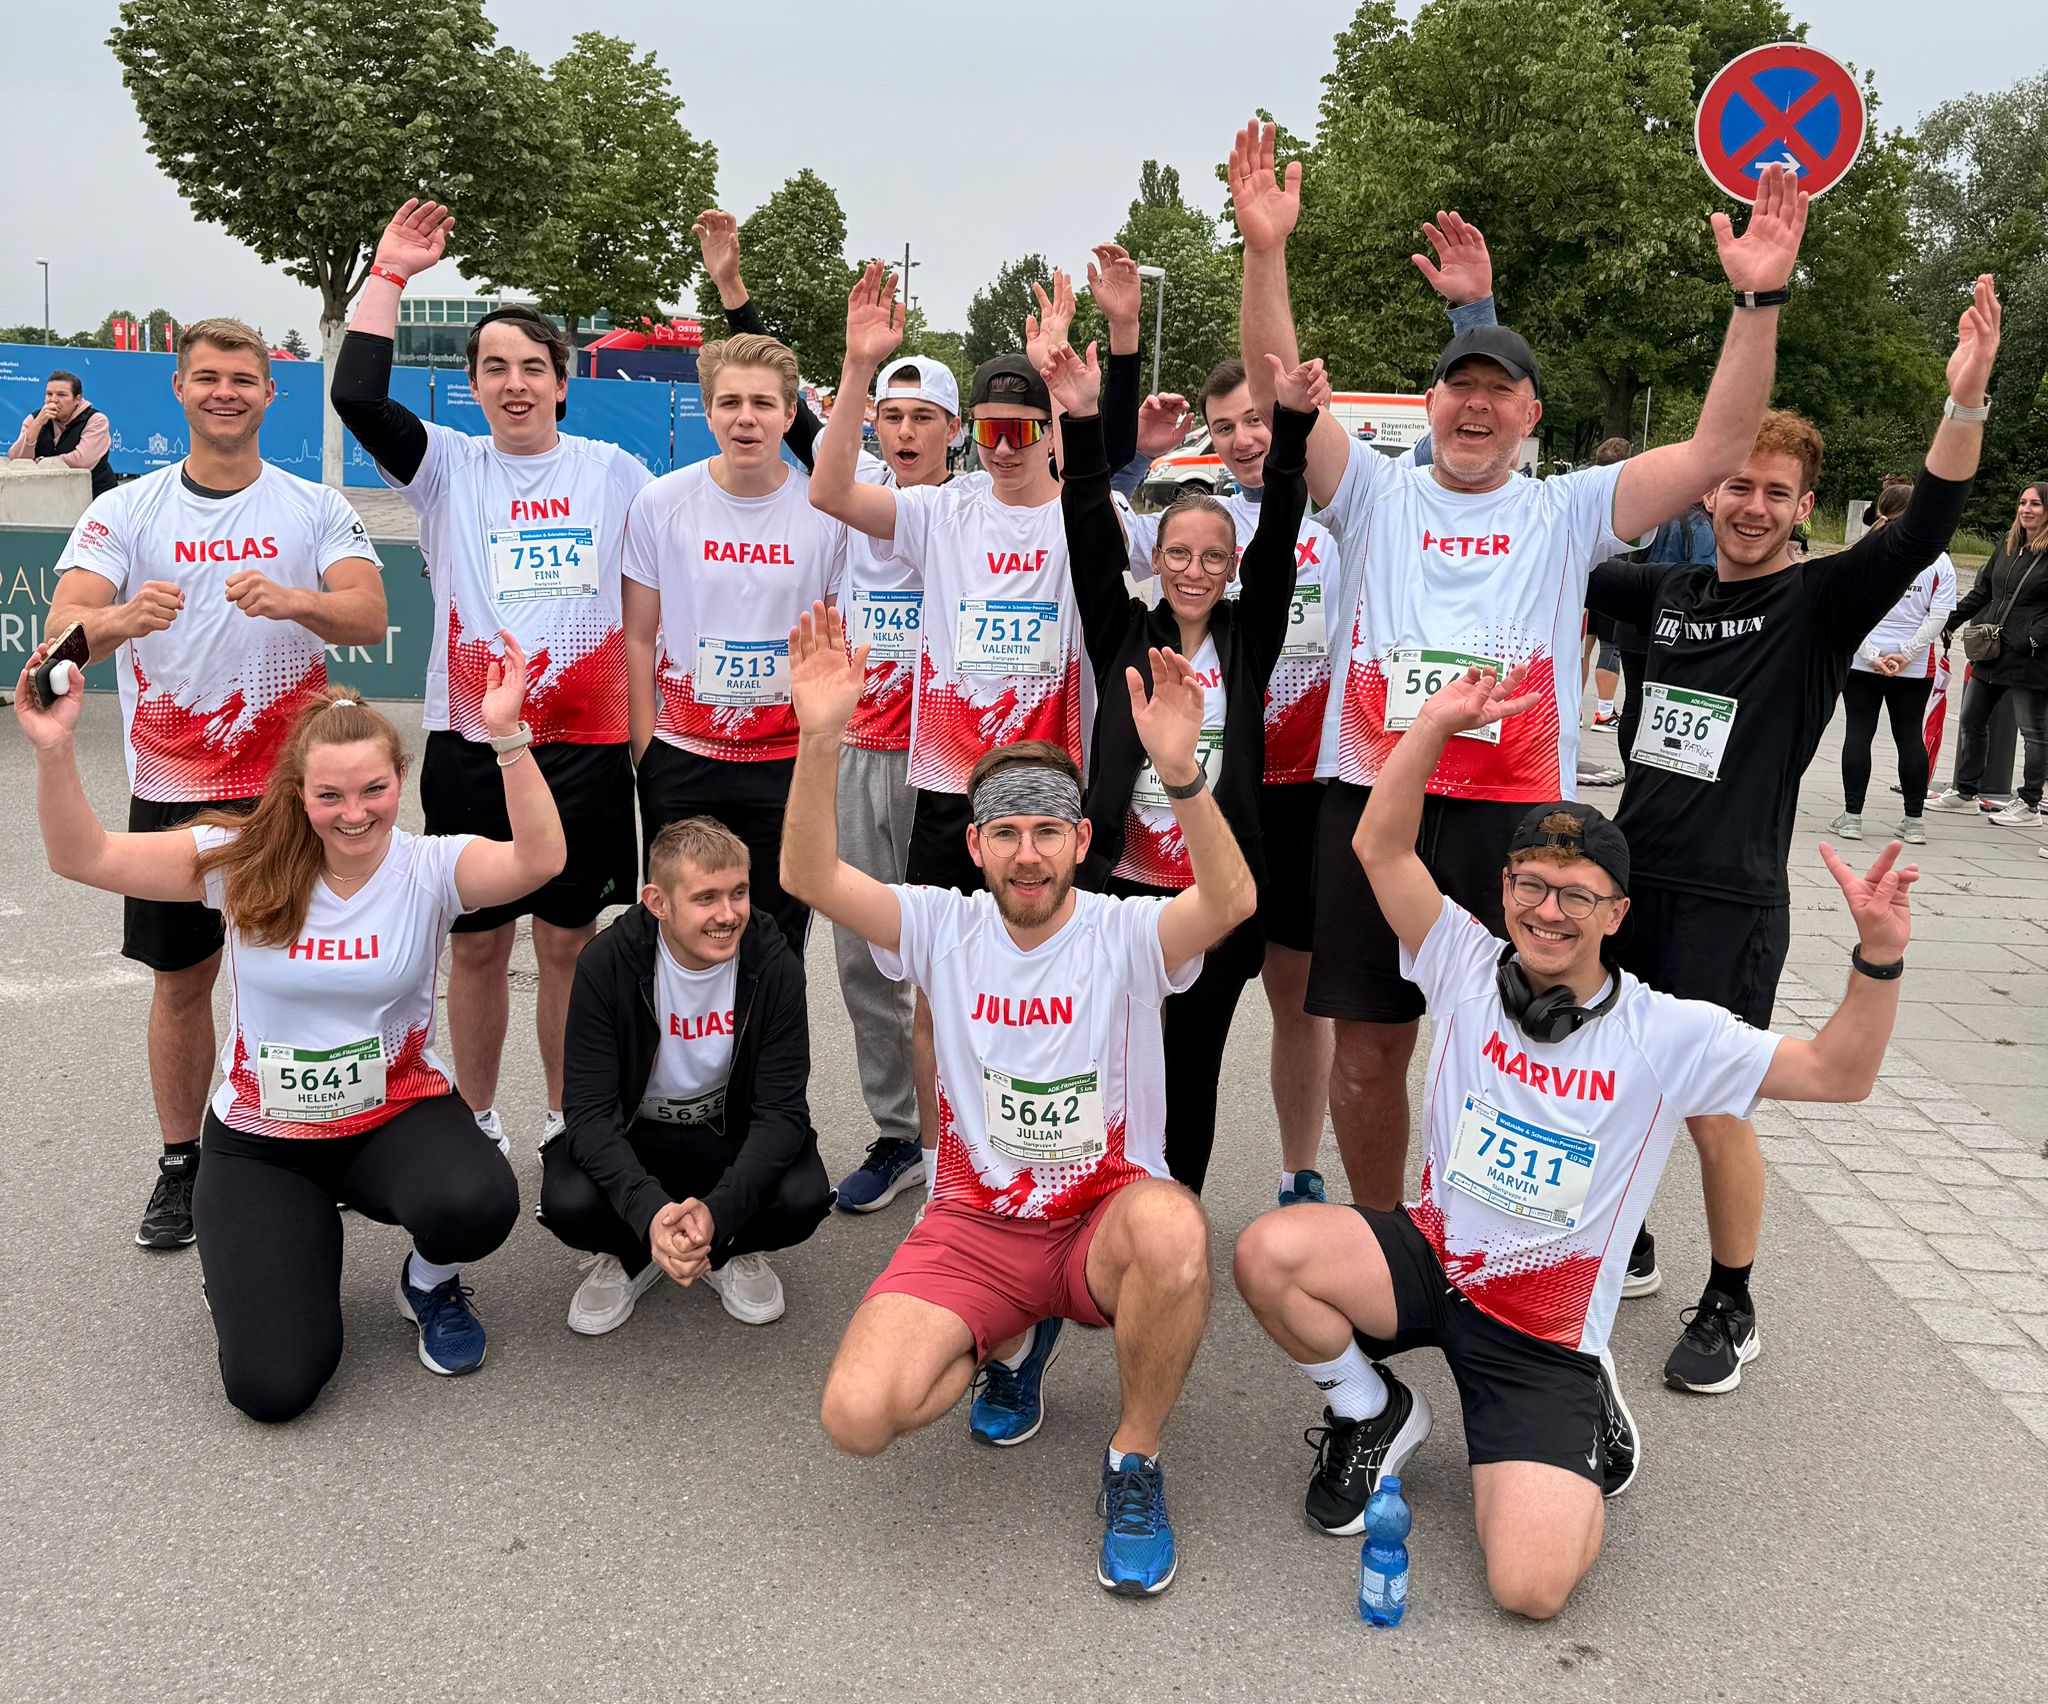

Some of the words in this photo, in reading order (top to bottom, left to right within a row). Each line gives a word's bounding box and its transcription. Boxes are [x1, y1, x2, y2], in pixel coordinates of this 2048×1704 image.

[1381, 422, 1425, 430] Bayerisches
[511, 496, 570, 521] FINN
[85, 520, 109, 537] SPD
[174, 536, 279, 563] NICLAS
[510, 544, 581, 570] 7514
[703, 539, 795, 565] RAFAEL
[534, 570, 560, 580] FINN
[862, 607, 920, 630] 7948
[974, 617, 1042, 643] 7512
[1720, 615, 1766, 638] RUN
[872, 632, 905, 642] NIKLAS
[981, 644, 1031, 655] VALENTIN
[714, 654, 776, 678] 7513
[726, 679, 761, 689] RAFAEL
[1651, 705, 1711, 741] 5636
[1682, 739, 1714, 759] PATRICK
[288, 934, 379, 961] HELLI
[971, 992, 1073, 1027] JULIAN
[669, 1010, 735, 1041] ELIAS
[280, 1061, 362, 1091] 5641
[1482, 1030, 1616, 1101] MARVIN
[298, 1090, 345, 1104] HELENA
[1000, 1093, 1081, 1127] 5642
[1016, 1127, 1063, 1141] JULIAN
[1477, 1126, 1564, 1187] 7511
[1569, 1153, 1579, 1161] 10
[1579, 1157, 1588, 1166] km
[1486, 1166, 1540, 1197] MARVIN
[1492, 1183, 1521, 1201] Startgruppe
